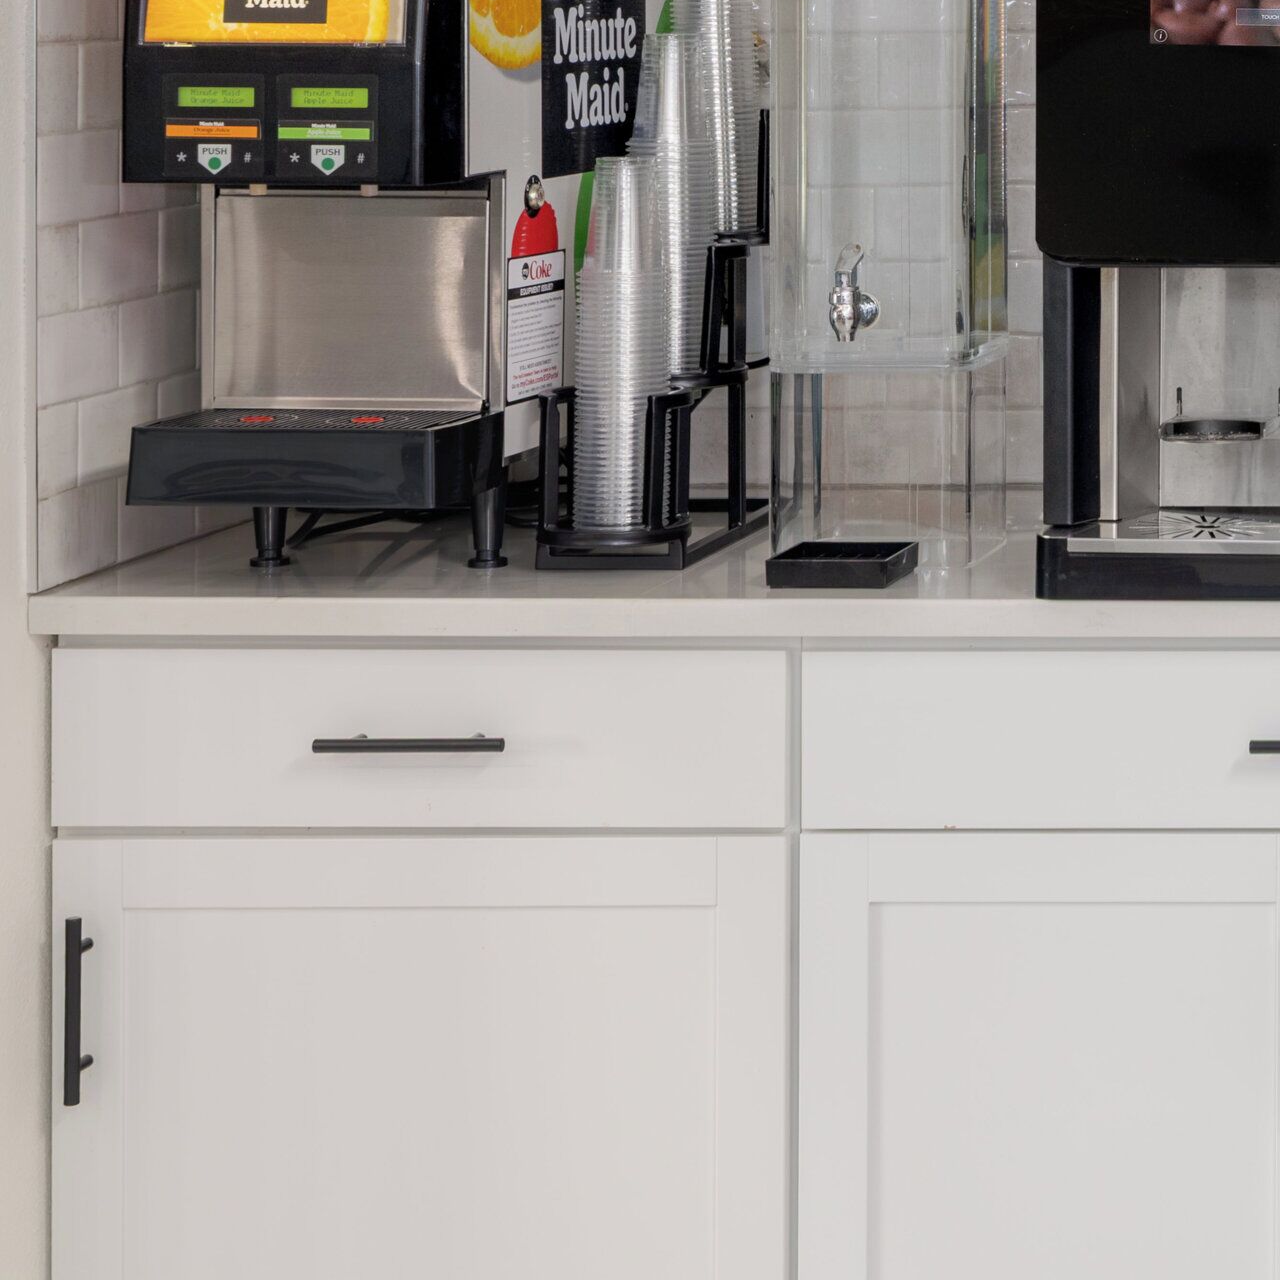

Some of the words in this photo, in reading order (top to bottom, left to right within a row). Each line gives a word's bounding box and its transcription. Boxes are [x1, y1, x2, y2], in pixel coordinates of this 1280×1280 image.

[553, 3, 637, 64] Minute
[565, 66, 627, 130] Maid
[202, 147, 228, 155] PUSH
[315, 148, 341, 156] PUSH
[530, 259, 553, 280] Coke
